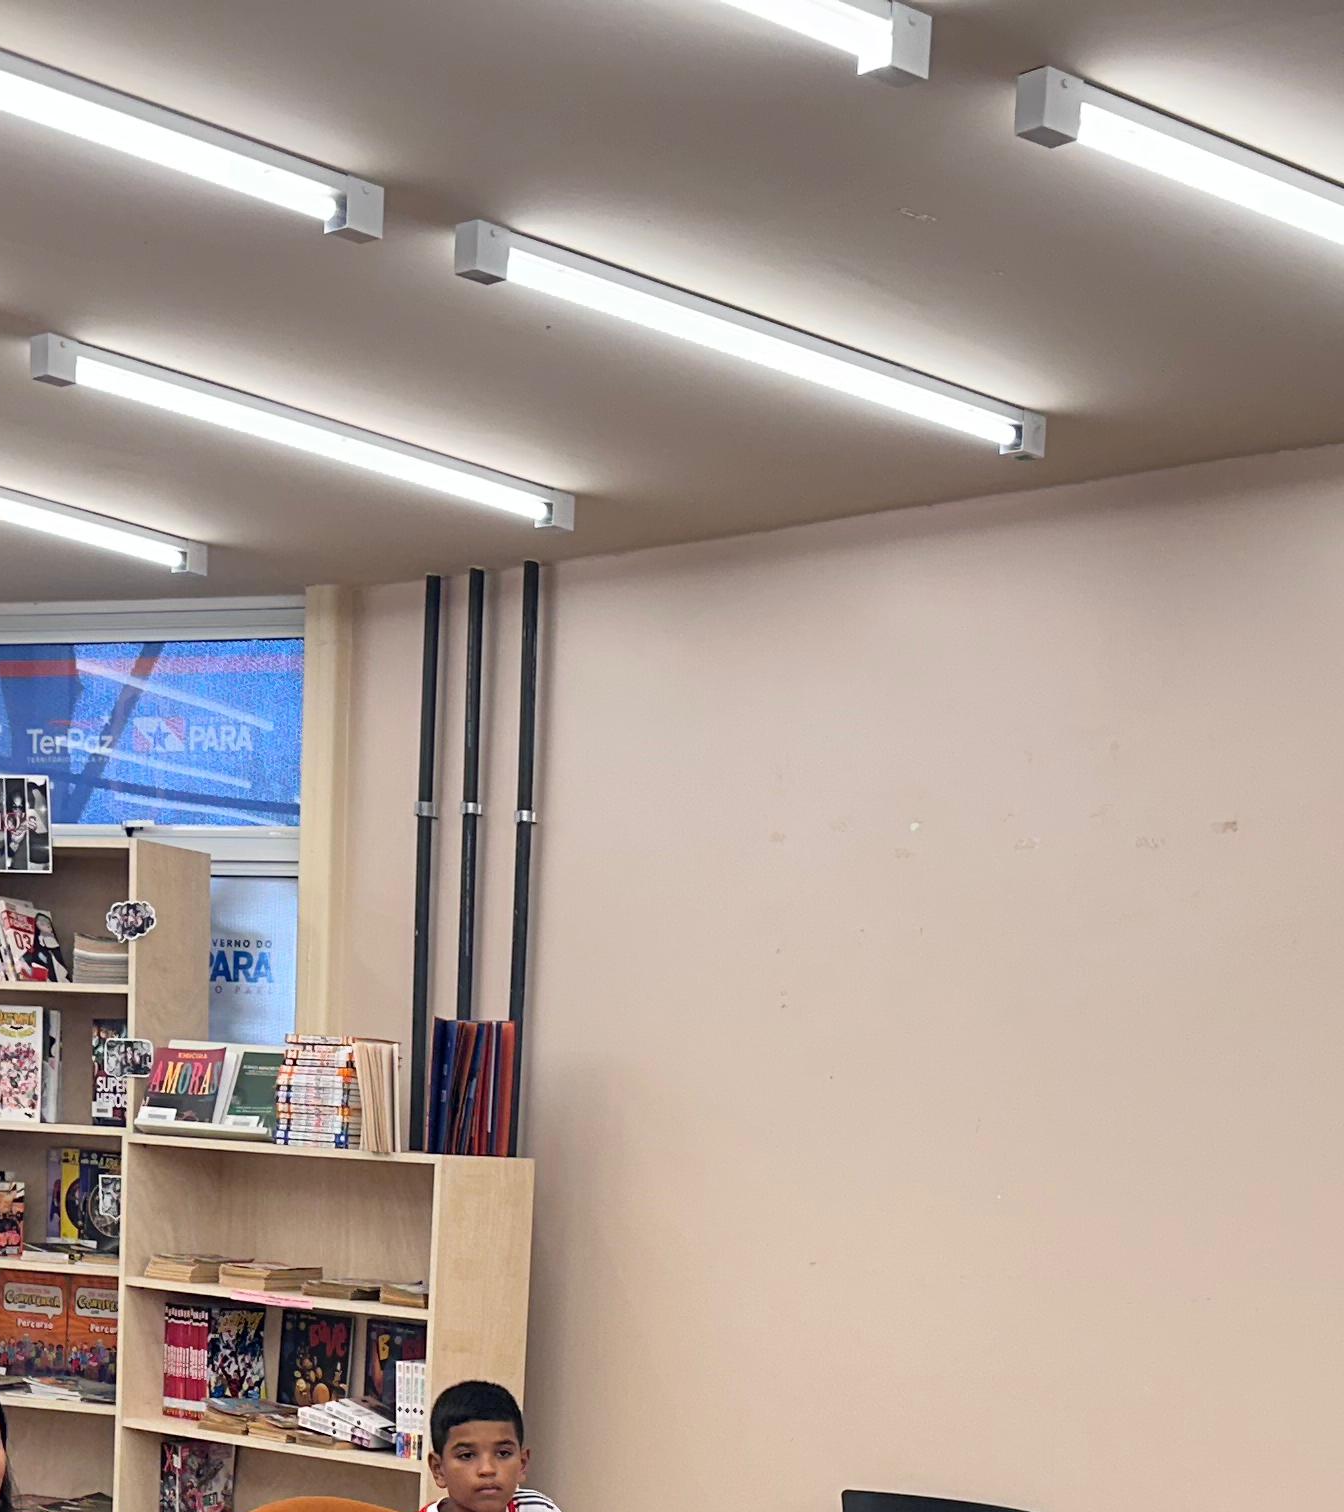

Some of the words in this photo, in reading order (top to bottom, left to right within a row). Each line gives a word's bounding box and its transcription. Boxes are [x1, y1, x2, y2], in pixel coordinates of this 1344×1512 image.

[26, 729, 114, 755] TerPaz
[256, 940, 273, 949] DO
[147, 1060, 223, 1096] AMORAS
[16, 1317, 55, 1330] Percurso
